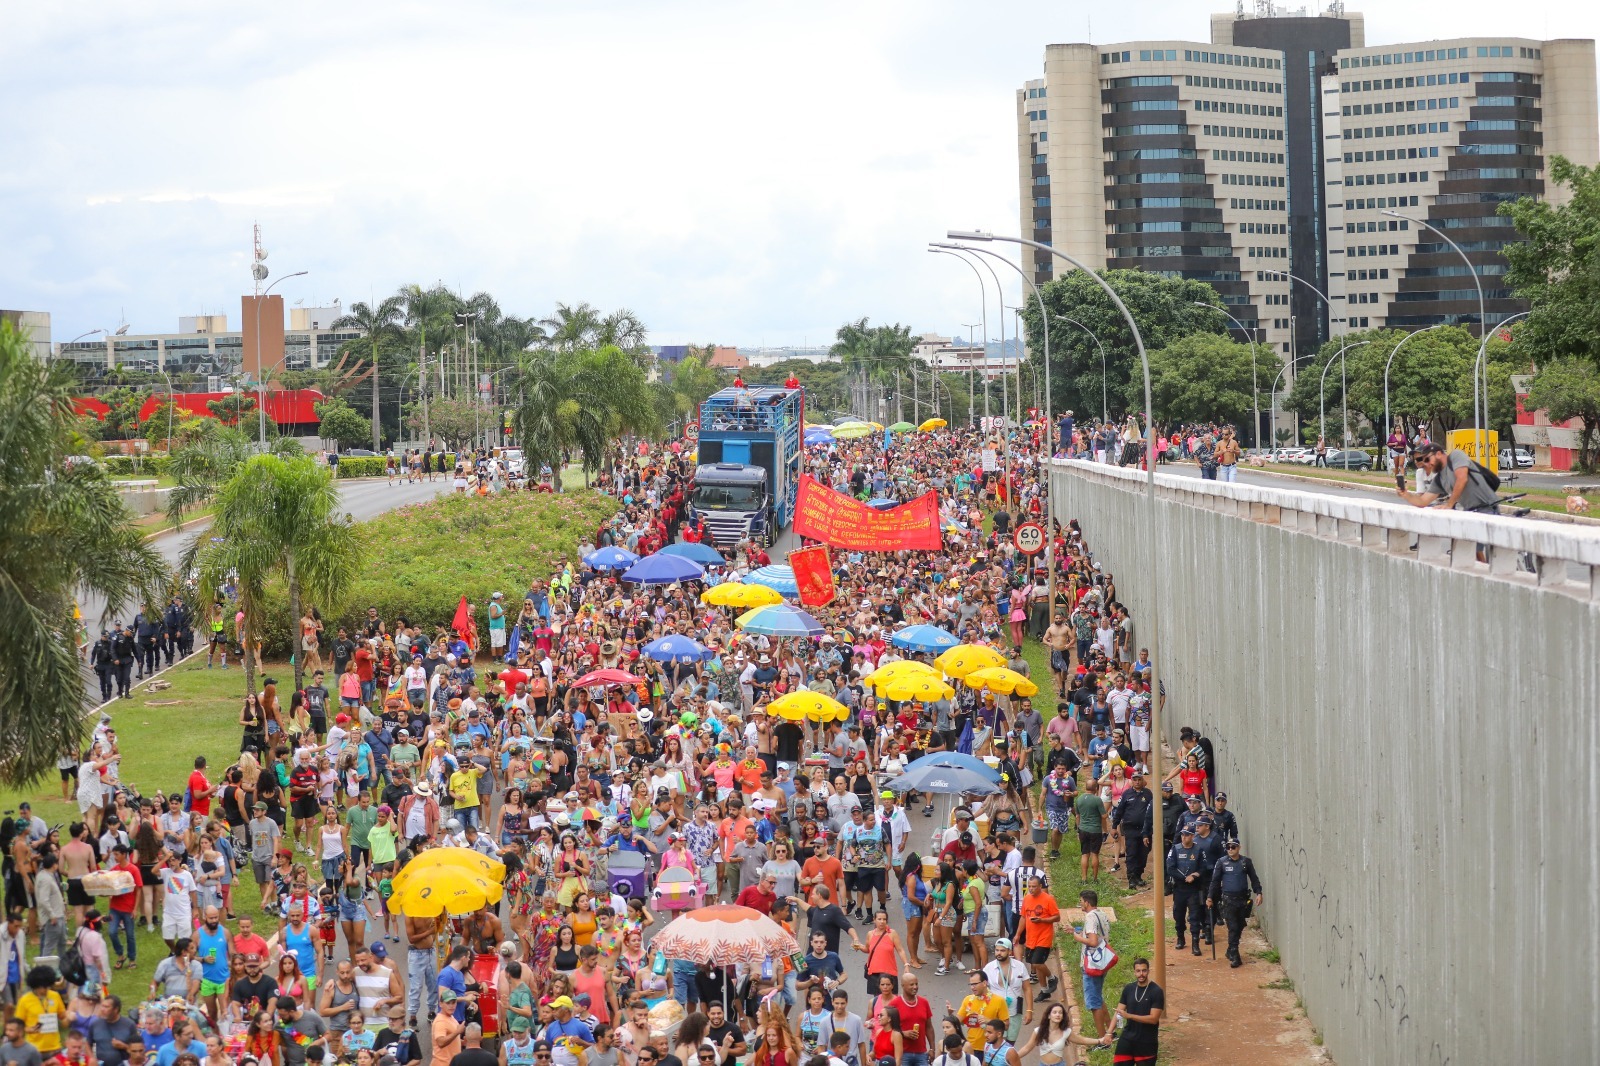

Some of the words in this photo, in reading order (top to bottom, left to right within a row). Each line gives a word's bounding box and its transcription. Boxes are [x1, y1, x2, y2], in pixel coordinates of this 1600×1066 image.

[688, 425, 698, 434] 60
[867, 509, 914, 524] LULA
[1021, 529, 1039, 539] 60
